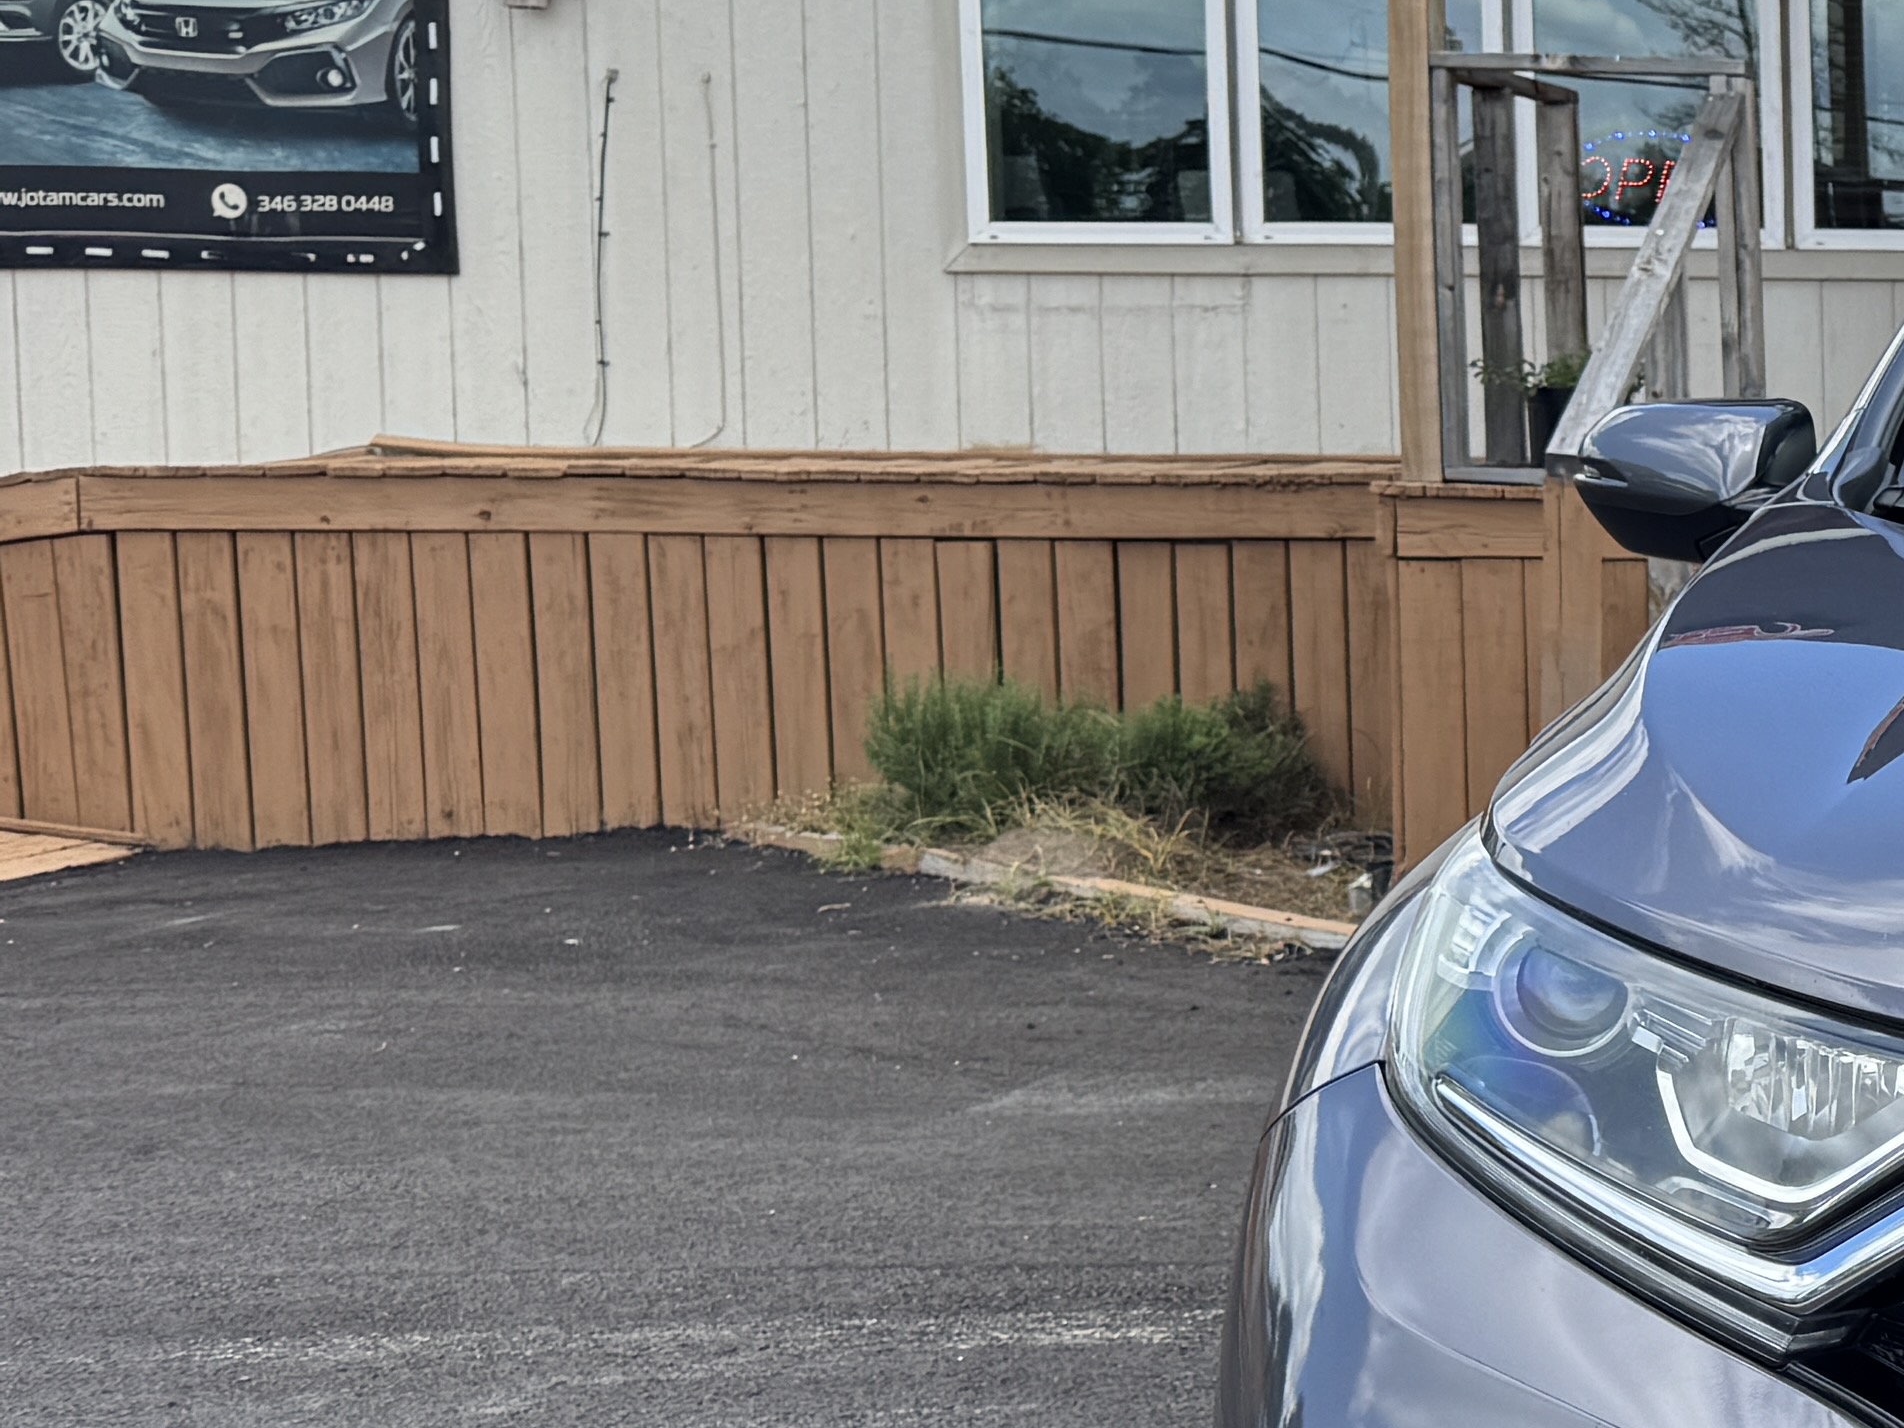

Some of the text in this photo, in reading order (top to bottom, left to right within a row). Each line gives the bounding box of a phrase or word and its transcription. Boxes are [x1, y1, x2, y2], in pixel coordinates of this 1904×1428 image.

[0, 188, 165, 208] w.jotamcars.com
[256, 195, 394, 213] 346 328 0448
